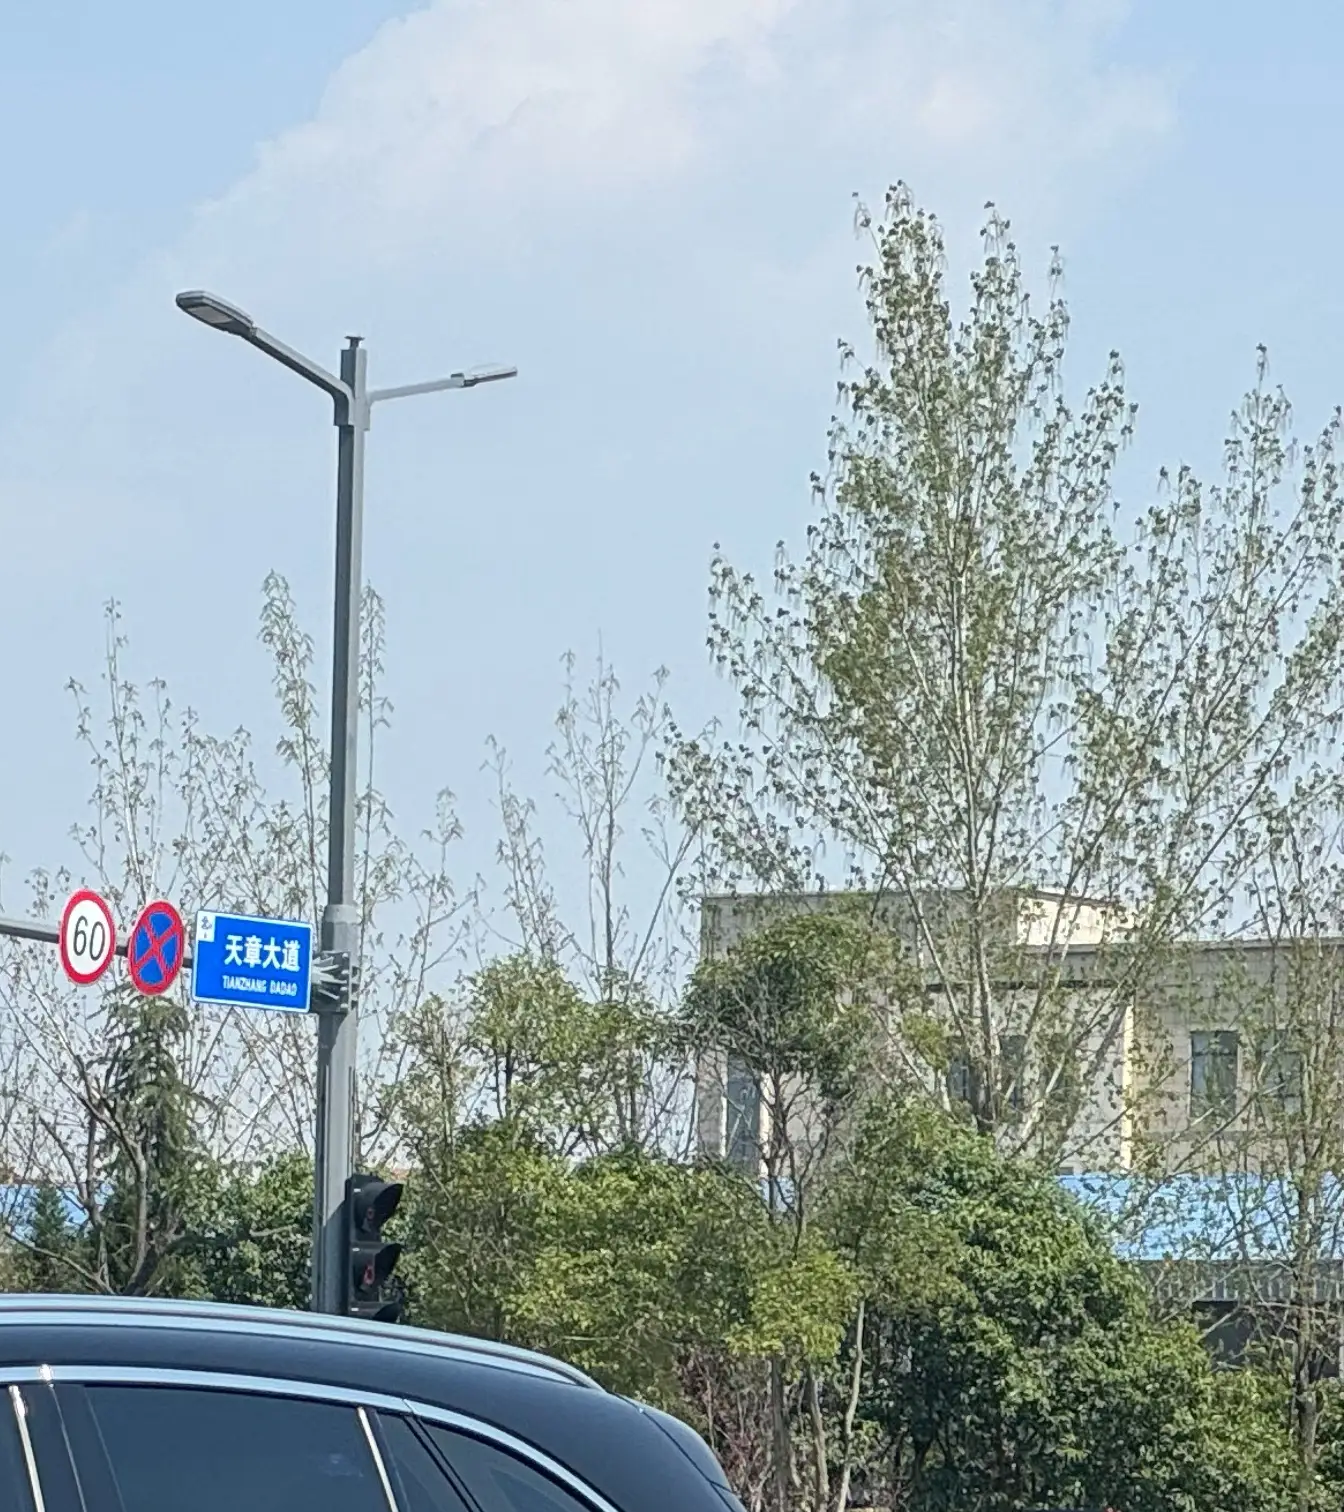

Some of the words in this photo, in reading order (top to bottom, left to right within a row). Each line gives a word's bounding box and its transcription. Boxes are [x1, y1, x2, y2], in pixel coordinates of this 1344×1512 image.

[73, 915, 106, 961] 60
[224, 934, 301, 972] 天章大道
[222, 974, 267, 994] TIANZHANG
[269, 979, 298, 997] DADAO
